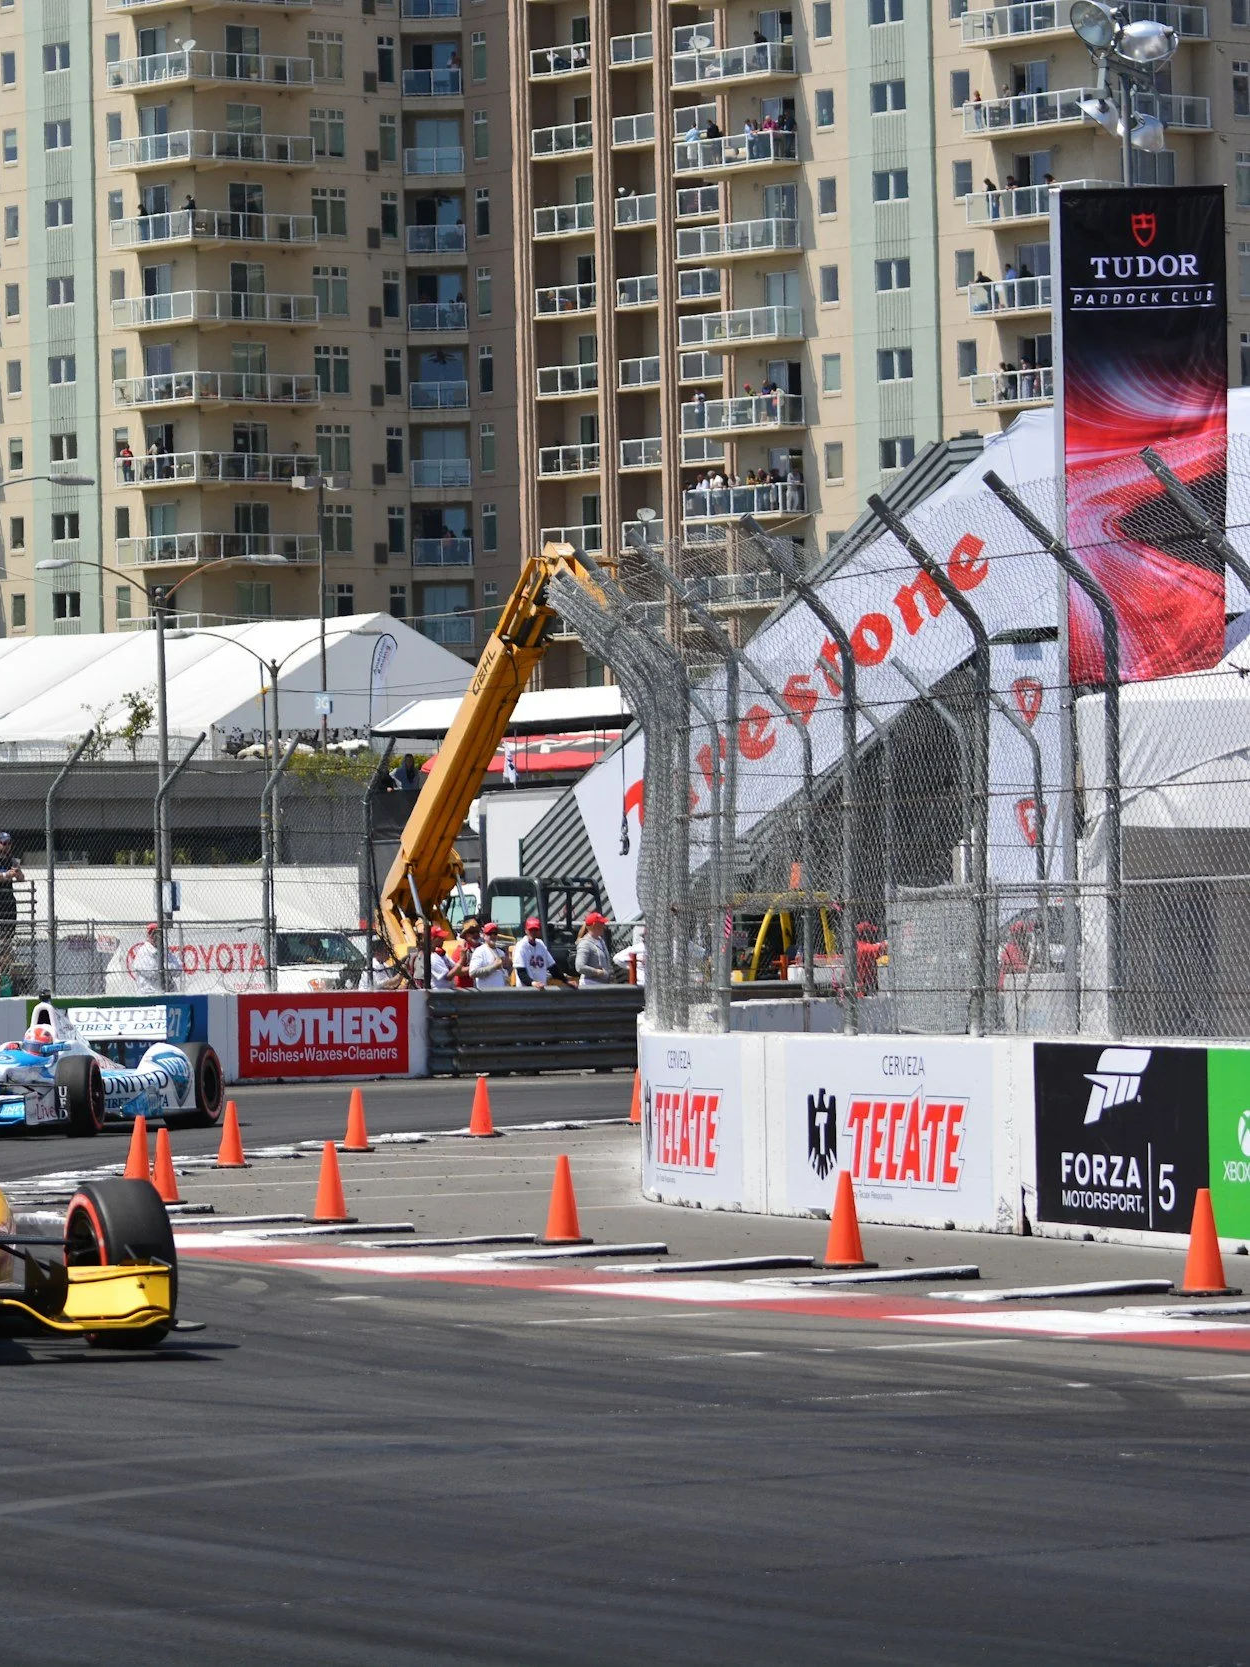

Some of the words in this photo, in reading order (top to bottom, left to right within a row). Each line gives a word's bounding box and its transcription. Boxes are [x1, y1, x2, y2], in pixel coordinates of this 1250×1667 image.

[1090, 254, 1199, 279] TUDOR
[1073, 291, 1159, 305] PADDOCK
[1171, 290, 1212, 303] CLUB
[472, 650, 497, 696] GEHL
[250, 1006, 398, 1046] MOTHERS
[666, 1050, 692, 1069] CERVEZA
[882, 1055, 925, 1076] CERVEZA
[655, 1088, 719, 1168] TECATE
[847, 1096, 964, 1184] TECATE
[1061, 1152, 1141, 1189] FORZA
[1158, 1164, 1175, 1211] 5
